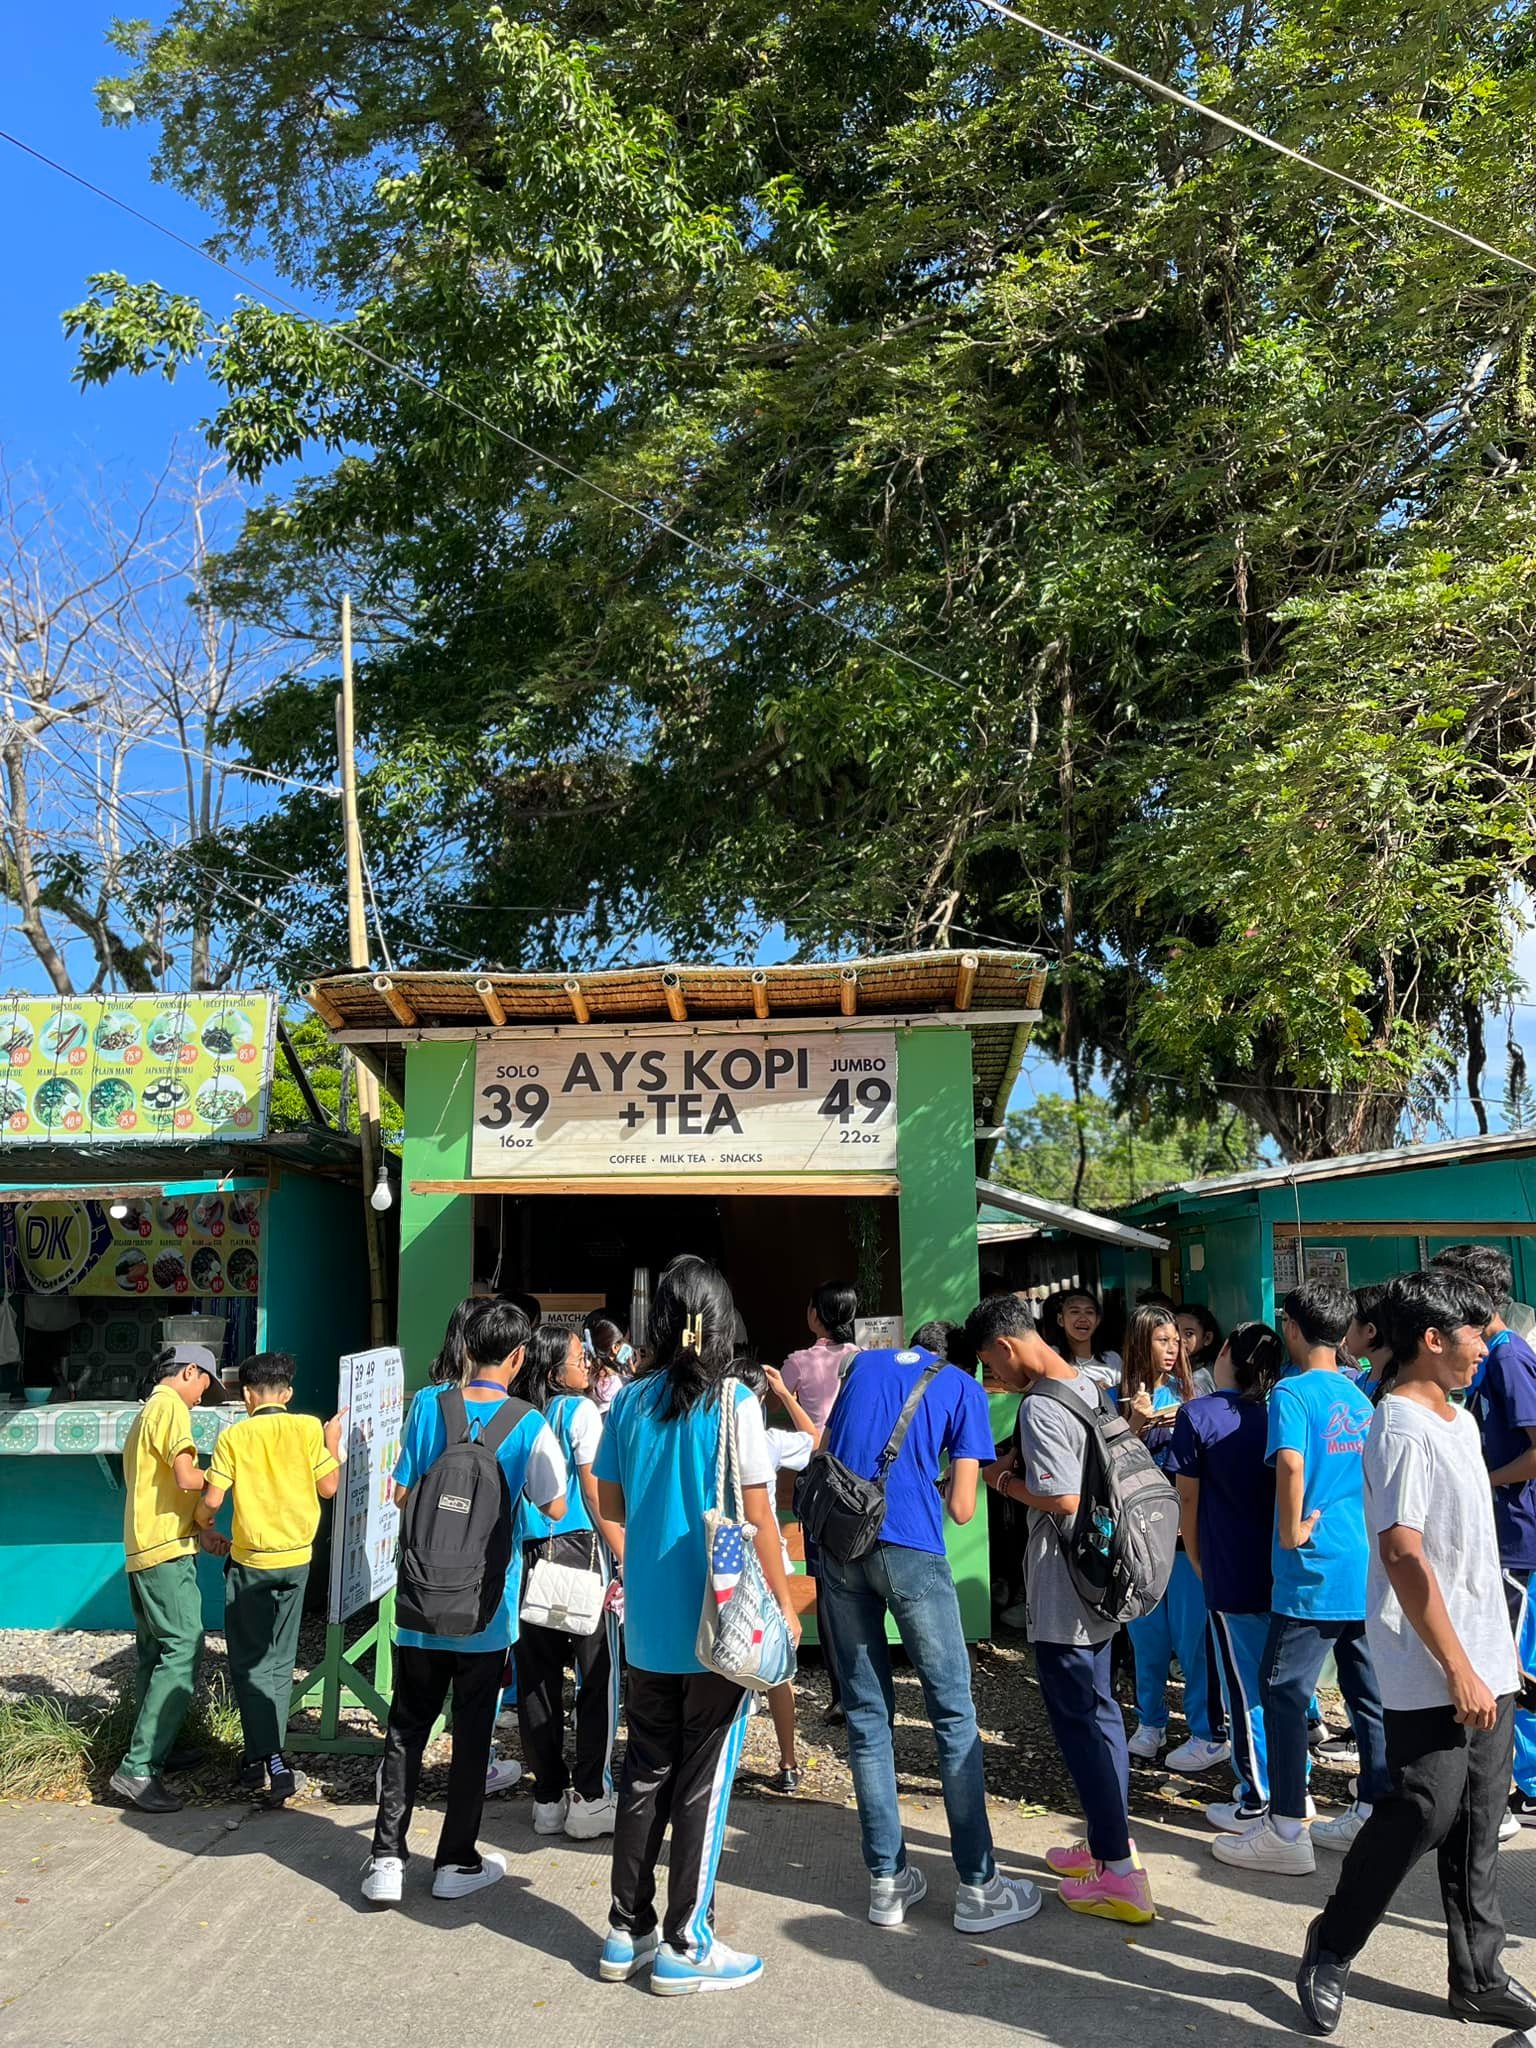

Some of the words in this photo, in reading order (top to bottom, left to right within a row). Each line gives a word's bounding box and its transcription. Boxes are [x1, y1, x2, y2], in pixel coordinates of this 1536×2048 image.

[496, 1065, 540, 1078] SOLO
[562, 1050, 667, 1092] AYS
[684, 1048, 808, 1090] KOPI
[830, 1058, 886, 1072] JUMBO
[479, 1083, 550, 1129] 39
[817, 1077, 892, 1124] 49
[619, 1093, 743, 1135] +TEA
[500, 1135, 533, 1148] 16oz
[840, 1130, 880, 1144] 22oz
[609, 1154, 647, 1164] COFFEE
[660, 1154, 684, 1163] MILK
[687, 1154, 706, 1163] TEA
[719, 1153, 763, 1163] SNACKS
[26, 1215, 74, 1260] DK
[547, 1313, 588, 1323] MATCHA
